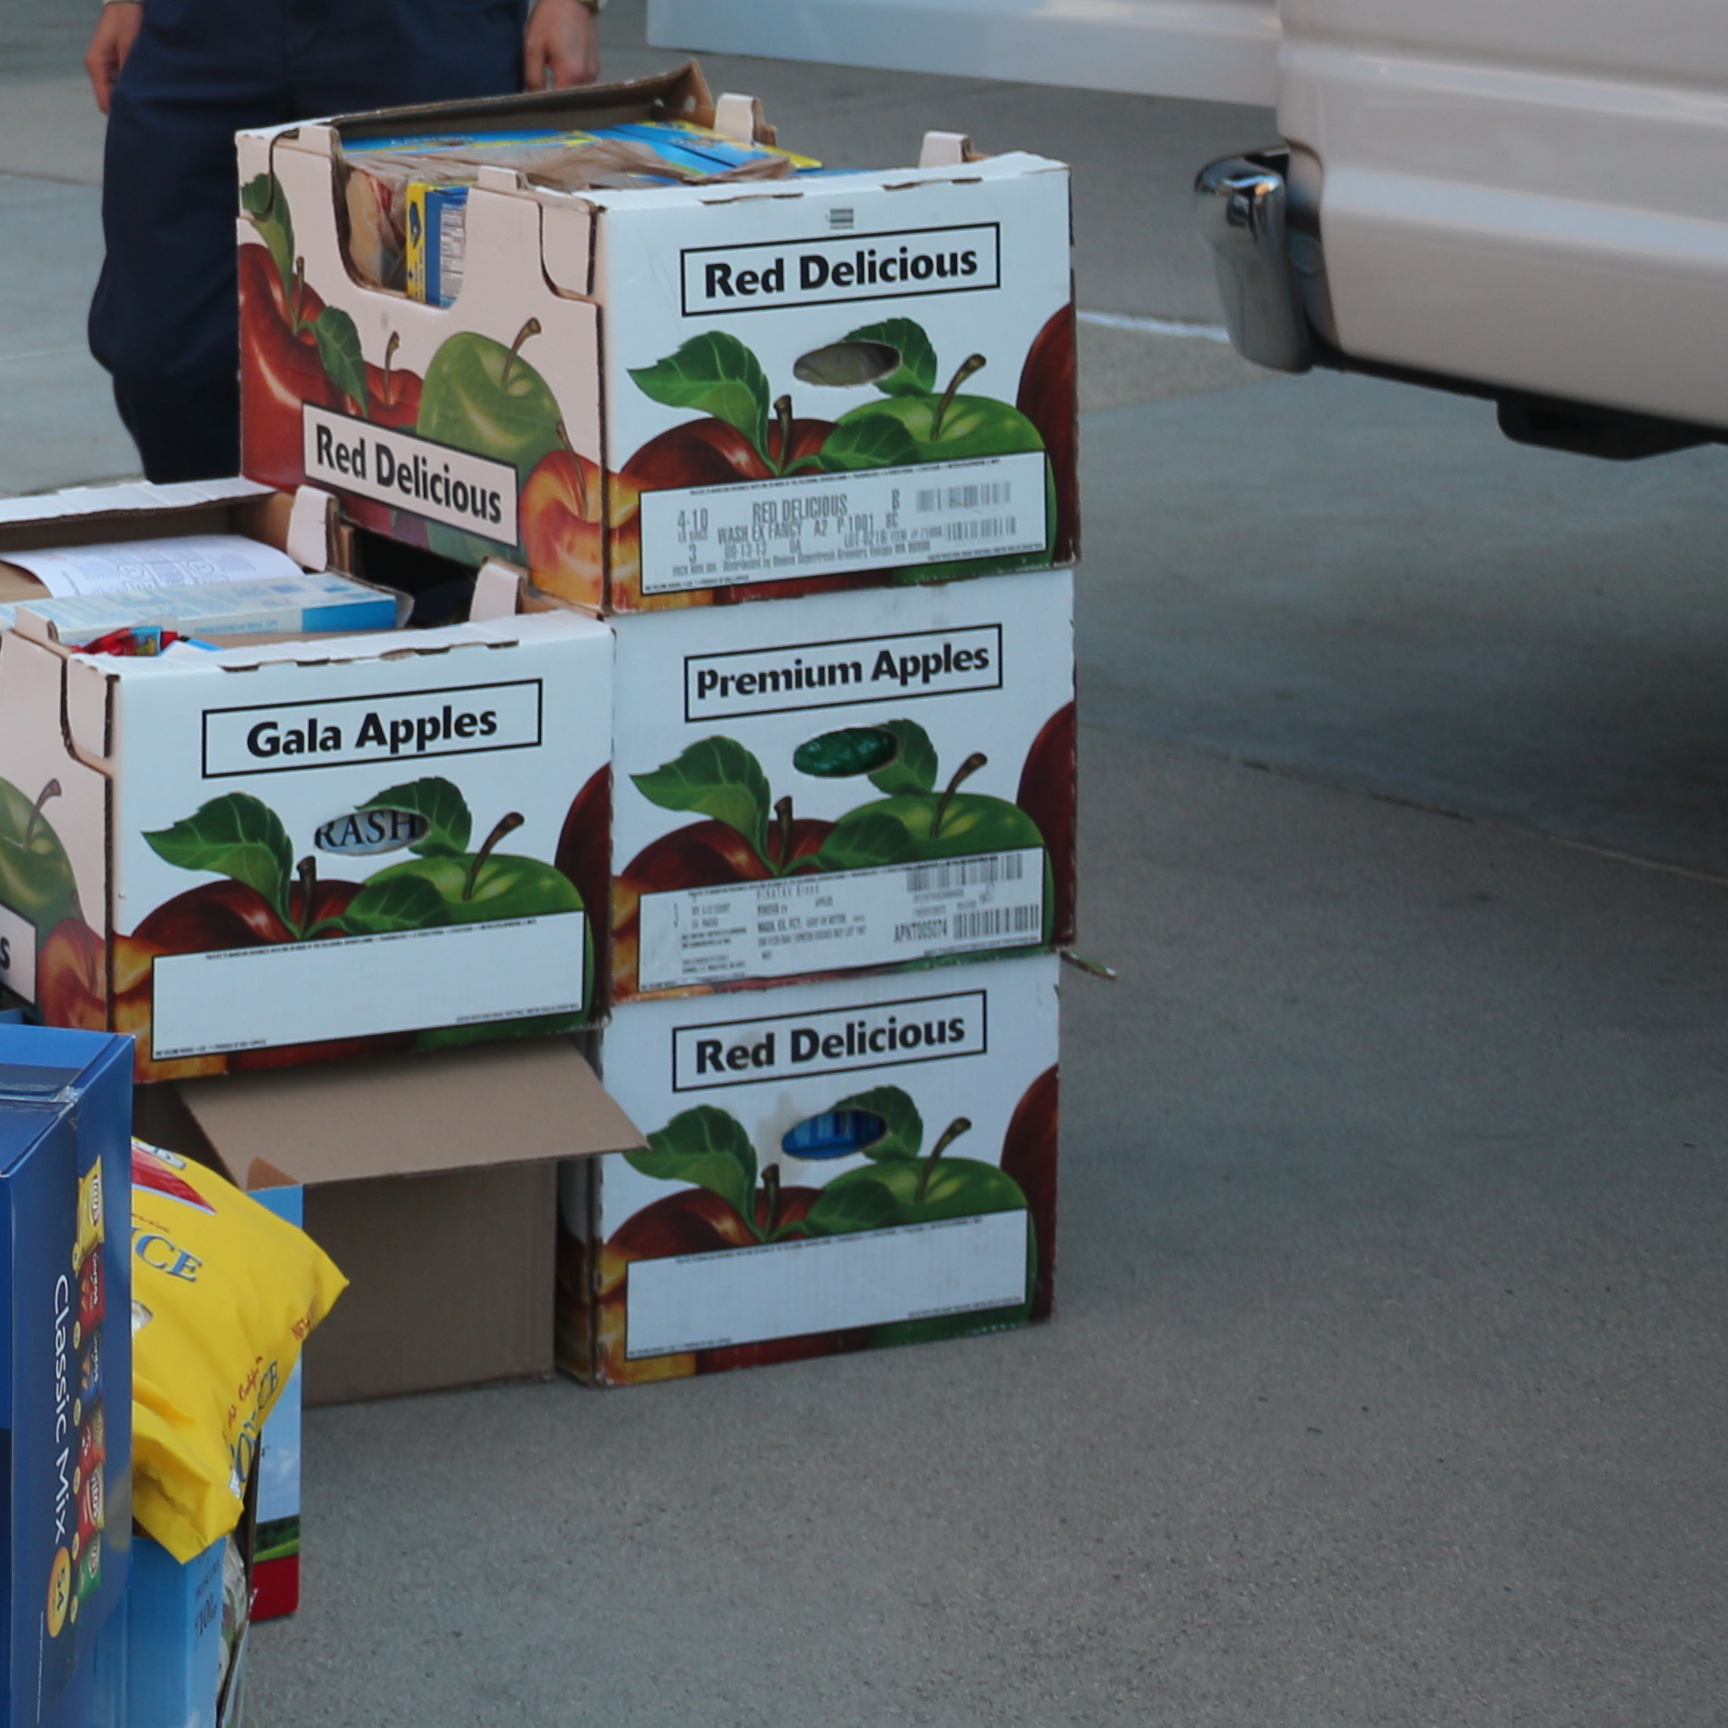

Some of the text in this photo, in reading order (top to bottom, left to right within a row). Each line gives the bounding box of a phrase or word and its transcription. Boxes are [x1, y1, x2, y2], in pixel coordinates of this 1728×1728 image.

[705, 243, 979, 300] Red Delicious
[315, 424, 502, 524] Red Delicious
[717, 524, 748, 545] WASH
[752, 494, 848, 523] RED DELICIOUS
[695, 643, 990, 703] Premium Apples
[247, 706, 498, 759] Gala Apples
[694, 1013, 967, 1075] Red Delicious
